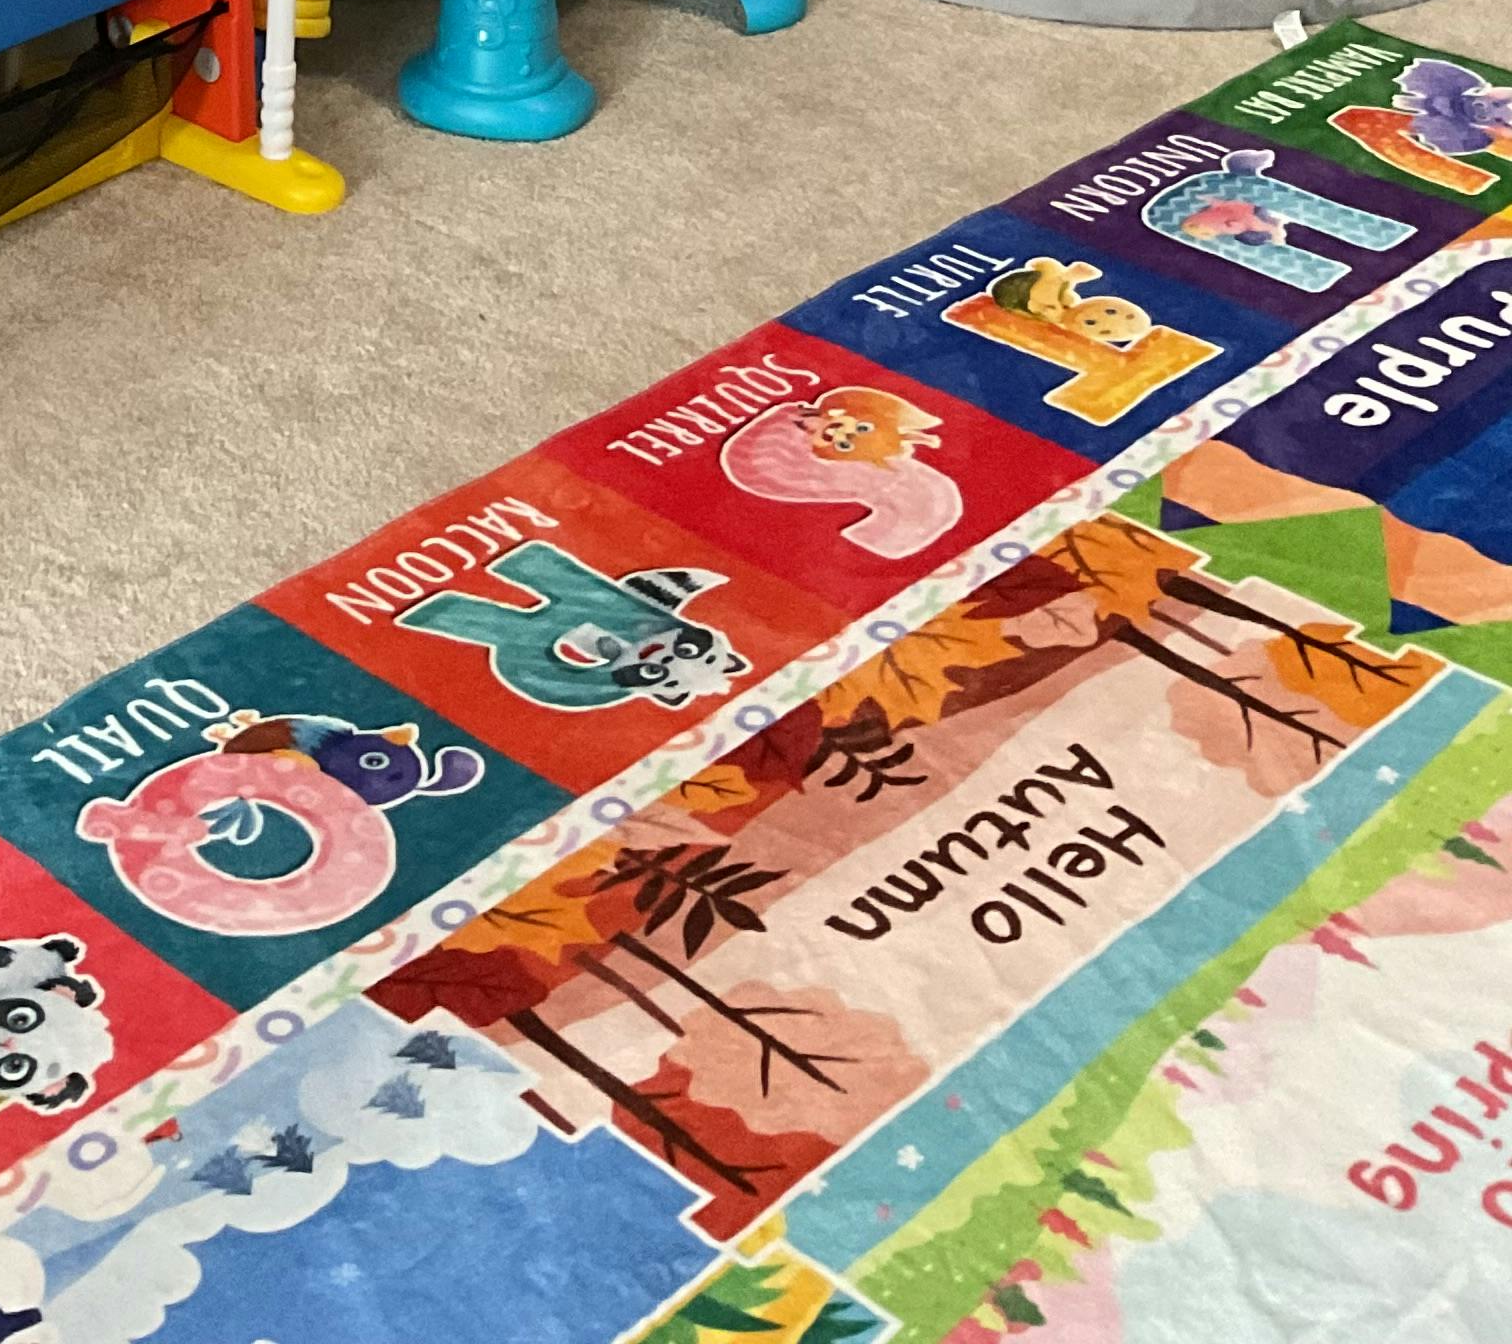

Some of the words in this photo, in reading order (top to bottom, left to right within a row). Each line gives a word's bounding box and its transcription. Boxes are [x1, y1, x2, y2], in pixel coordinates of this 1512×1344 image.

[1234, 90, 1306, 124] BAT
[1272, 43, 1404, 100] VAMPIRE
[1050, 134, 1230, 222] UNICORN
[852, 243, 1015, 318] TURTLE
[607, 352, 822, 466] SQUIRREL
[325, 497, 560, 625] RACCOON
[33, 677, 230, 784] QUAIL
[825, 742, 1116, 942] Autumn
[971, 804, 1166, 945] Hello
